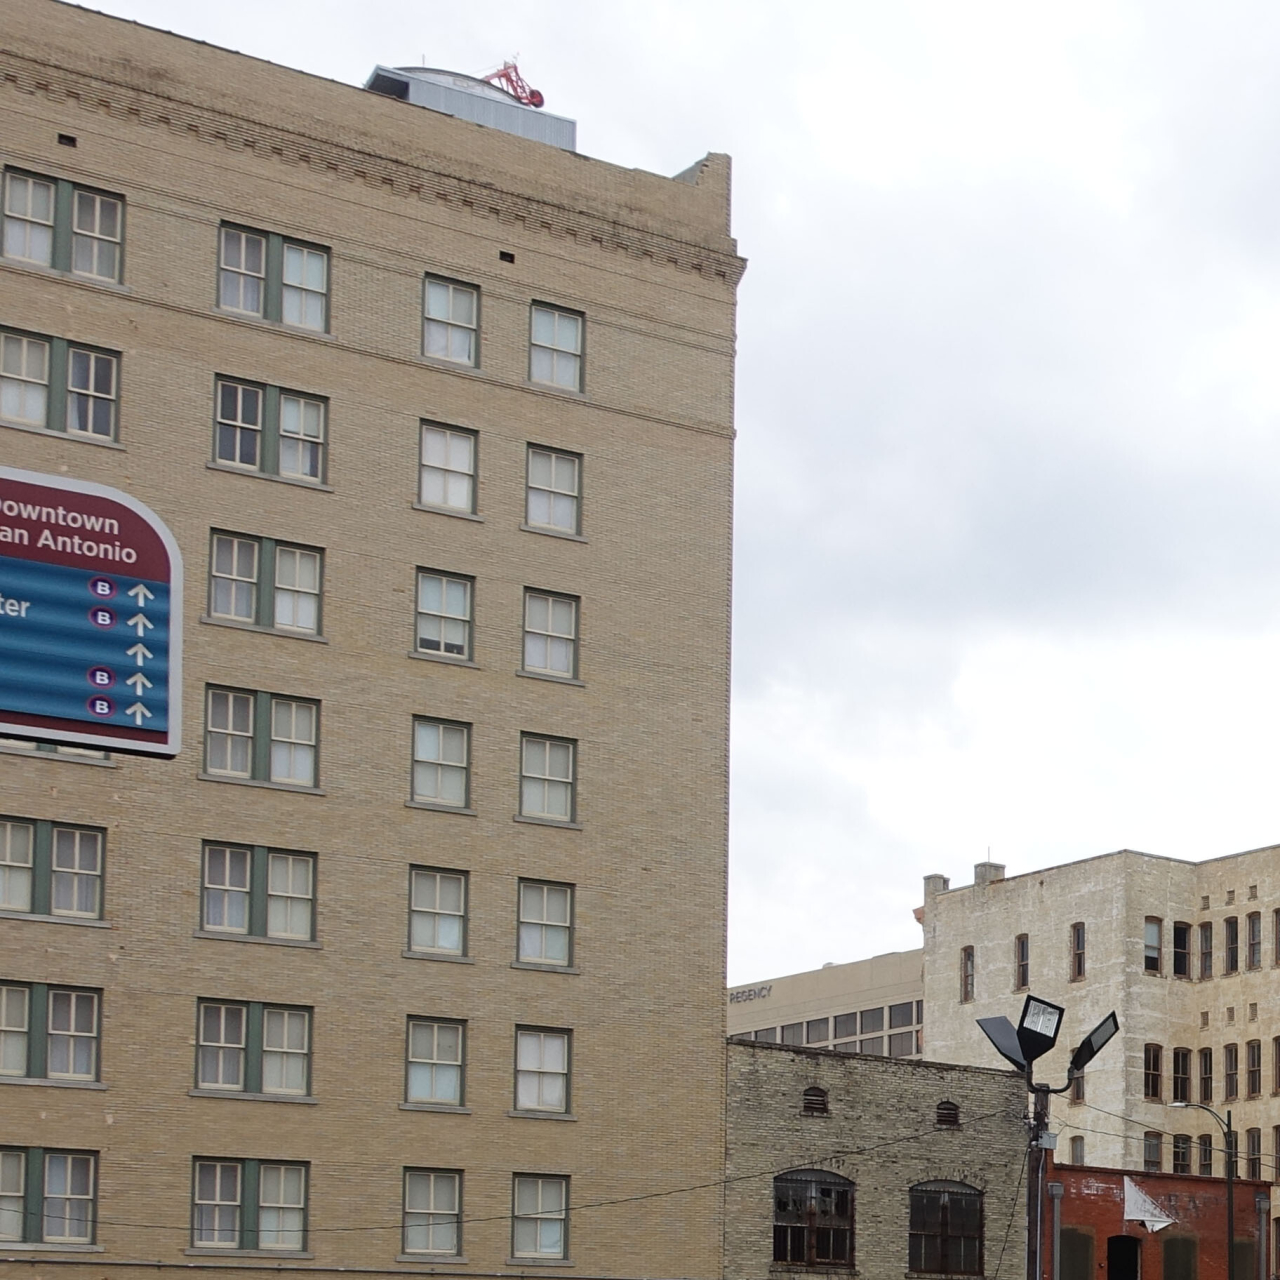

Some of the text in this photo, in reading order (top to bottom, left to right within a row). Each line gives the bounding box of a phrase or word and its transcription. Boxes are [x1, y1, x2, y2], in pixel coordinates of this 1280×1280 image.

[0, 498, 119, 535] owntown
[37, 528, 137, 564] Antonio
[729, 985, 773, 1005] REGENCY
